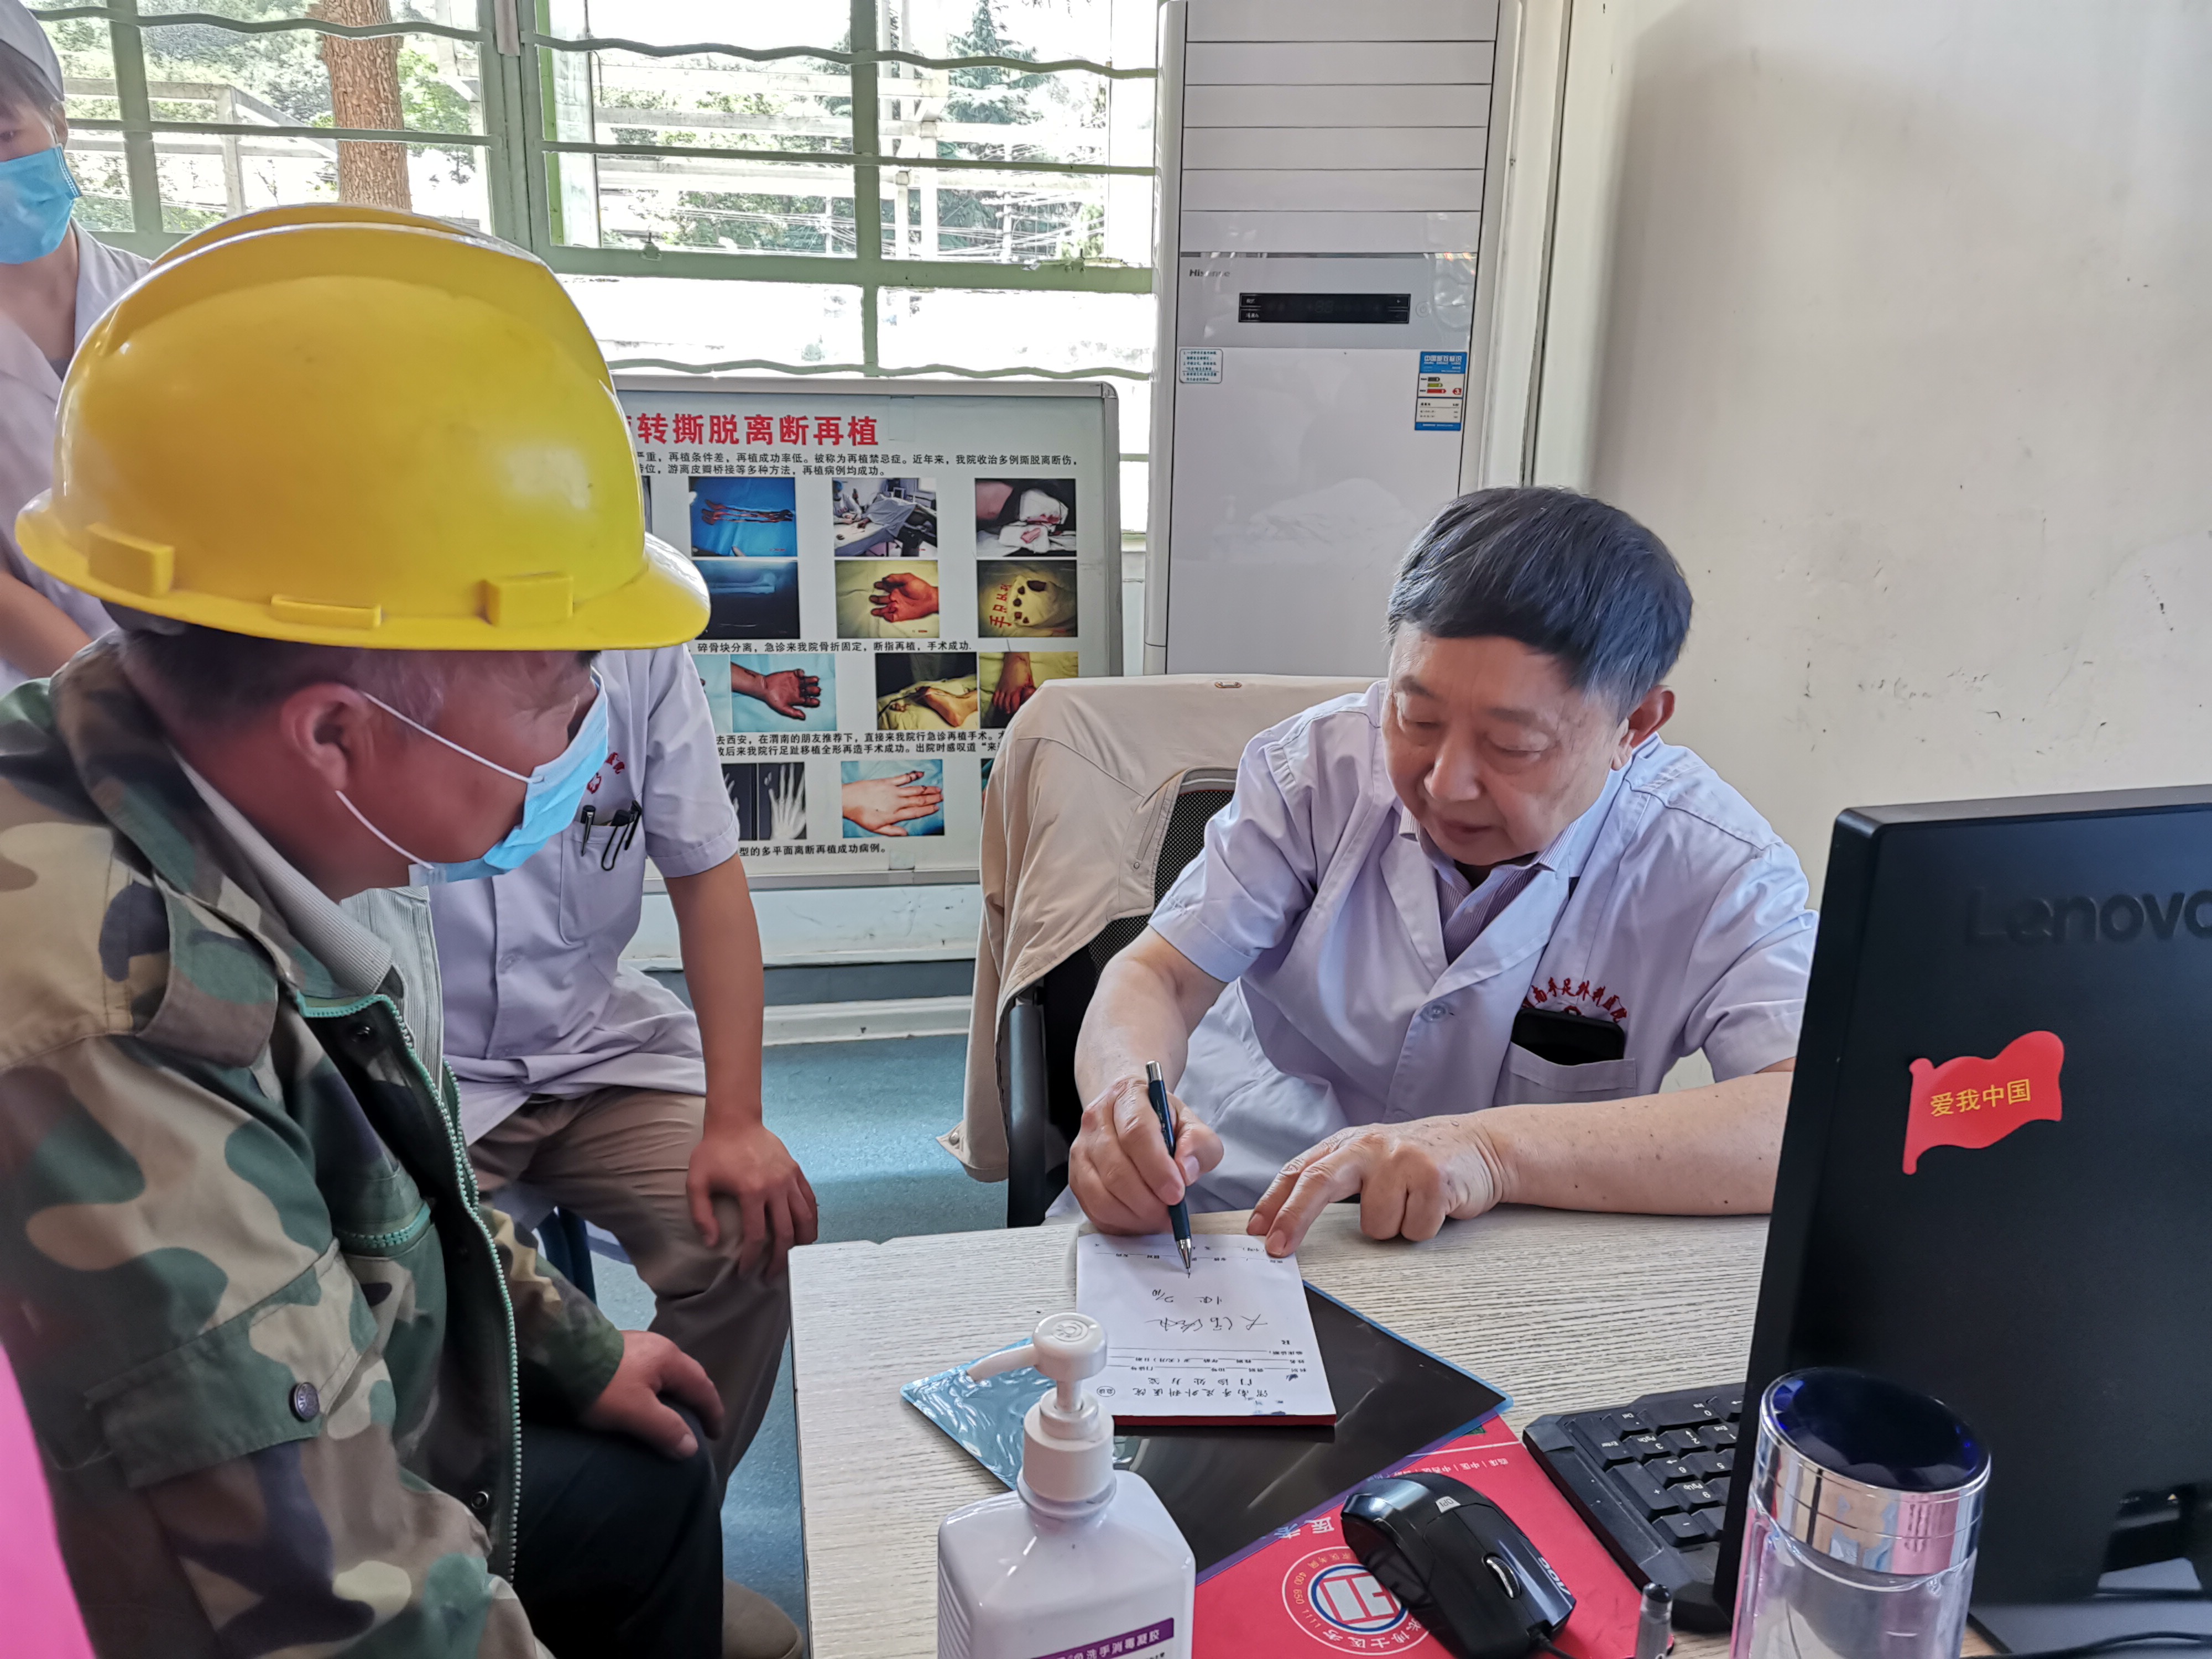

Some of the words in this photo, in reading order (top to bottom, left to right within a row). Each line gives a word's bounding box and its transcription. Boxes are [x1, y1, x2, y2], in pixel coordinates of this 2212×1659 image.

[627, 413, 879, 446] 转撕脱离断再植
[1930, 1078, 2031, 1117] 爱我中国
[1439, 1498, 1454, 1507] DPI
[1538, 1557, 1572, 1595] AOC
